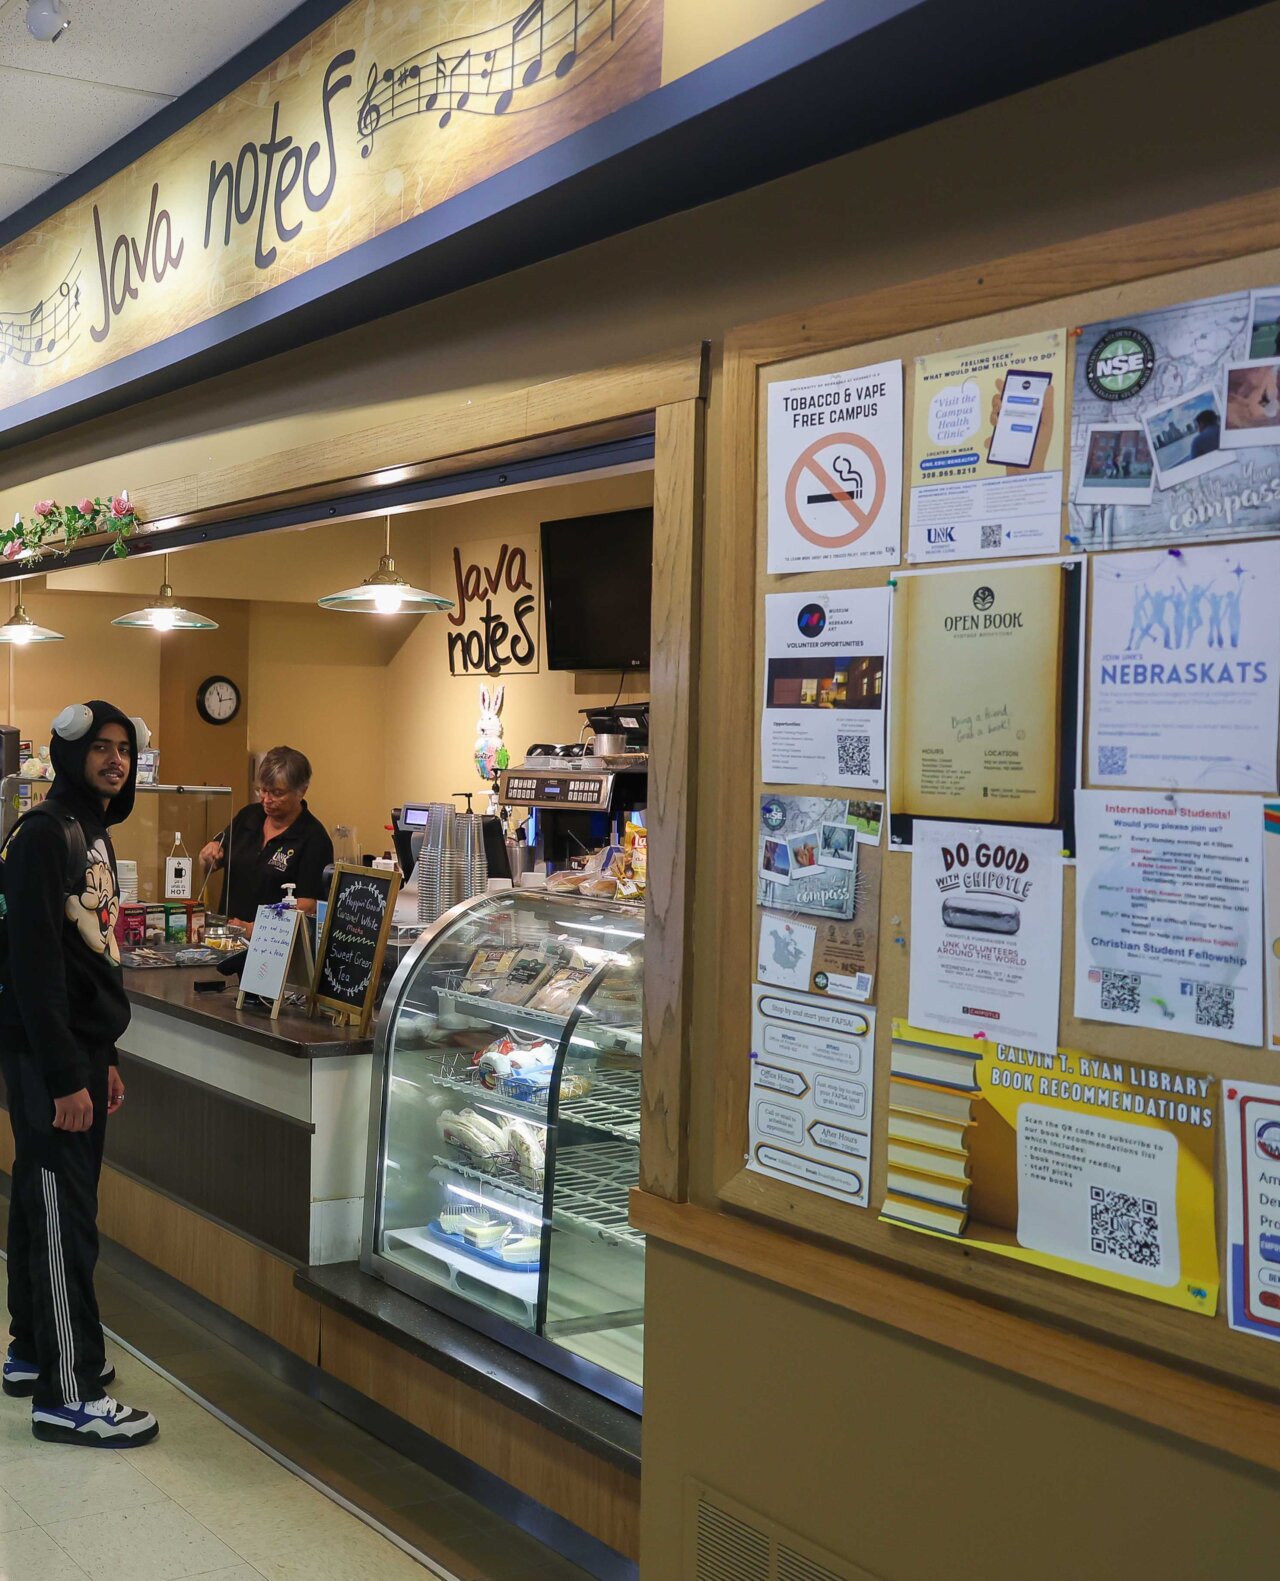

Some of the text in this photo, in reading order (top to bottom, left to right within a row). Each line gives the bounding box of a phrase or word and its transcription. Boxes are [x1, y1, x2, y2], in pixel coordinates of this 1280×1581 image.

[90, 48, 356, 343] Java notes
[960, 353, 1014, 367] FEELING SICK?
[1097, 353, 1144, 377] NSE
[944, 368, 969, 377] WOULD
[972, 364, 990, 372] MOM
[783, 382, 886, 412] TOBACCO & VAPE
[961, 394, 977, 403] the
[793, 403, 878, 428] FREE CAMPUS
[935, 407, 973, 419] Campus
[938, 418, 969, 429] Health
[927, 527, 956, 544] UNK
[944, 612, 1023, 631] OPEN BOOK
[447, 594, 535, 674] notes
[820, 640, 864, 648] OPPORTUNITIES
[1101, 661, 1268, 684] NEBRASKATS
[1105, 804, 1231, 820] International Students!
[1113, 820, 1142, 828] Would
[1143, 821, 1159, 830] you
[1161, 822, 1189, 831] please
[1190, 824, 1207, 832] join
[1152, 837, 1175, 845] Sunday
[1177, 839, 1201, 847] evening
[940, 842, 1029, 874] DO GOOD
[936, 871, 1033, 898] WITH CHIPOTLE
[796, 886, 850, 906] compass
[360, 914, 378, 931] White
[330, 942, 372, 969] Sweet Green
[937, 946, 1027, 967] AROUND THE WORLD
[942, 940, 1019, 957] UNK VOLUNTEERS
[1091, 937, 1247, 967] Christian Student Fellowship
[339, 965, 350, 982] Tea
[841, 961, 864, 973] NSE
[772, 1004, 784, 1014] Stop
[785, 1007, 791, 1015] by
[792, 1009, 803, 1017] and
[804, 1011, 817, 1019] start
[818, 1015, 830, 1023] your
[760, 1069, 794, 1084] Office Hours
[996, 1043, 1209, 1098] CALVIN T. RYAN LIBRARY
[991, 1067, 1213, 1129] BOOK RECOMMENDATIONS
[821, 1128, 858, 1145] After Hours
[1025, 1116, 1042, 1125] Scan
[1045, 1120, 1059, 1129] the
[1061, 1124, 1073, 1133] QR
[1075, 1127, 1095, 1137] code
[1097, 1132, 1106, 1140] to
[1109, 1135, 1151, 1149] subscribe
[1025, 1135, 1048, 1145] which
[1040, 1128, 1060, 1138] book
[1062, 1134, 1139, 1156] recommendations
[1141, 1150, 1156, 1160] list
[1029, 1145, 1121, 1173] recommended reading
[1030, 1154, 1083, 1172] book reviews
[1030, 1163, 1073, 1179] staff picks
[1030, 1172, 1073, 1188] new books
[1110, 1217, 1143, 1237] UNK
